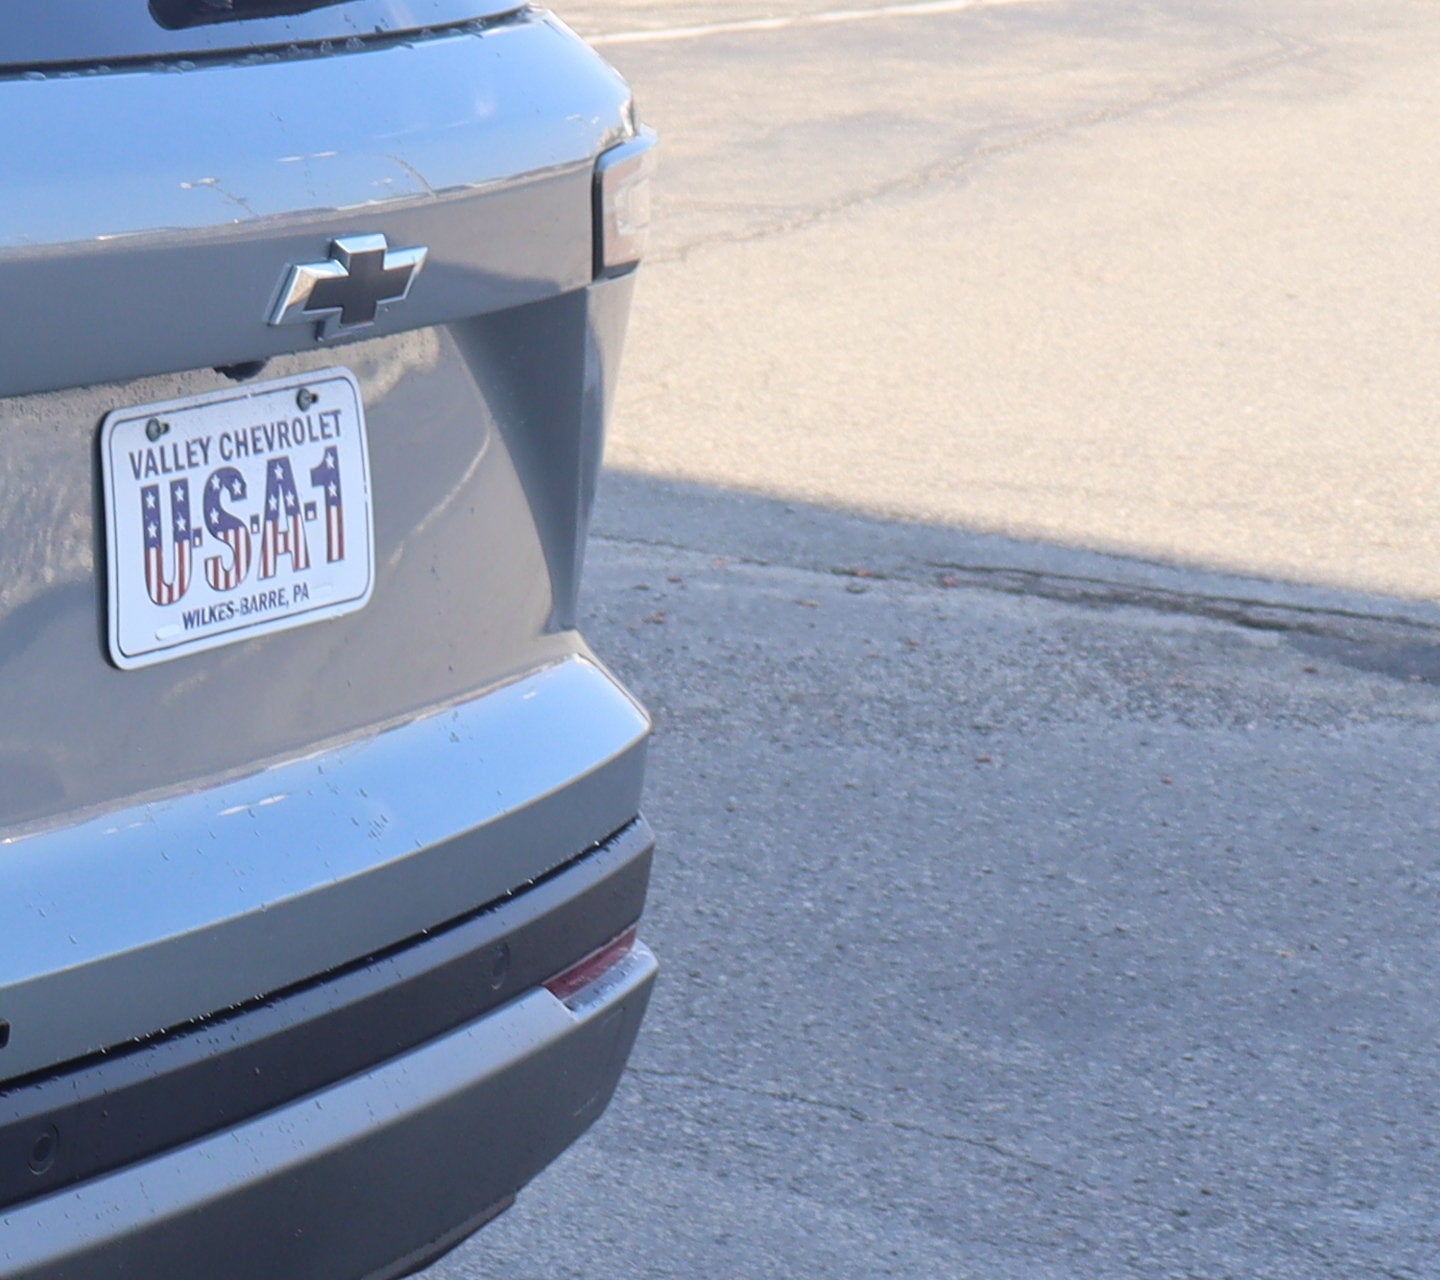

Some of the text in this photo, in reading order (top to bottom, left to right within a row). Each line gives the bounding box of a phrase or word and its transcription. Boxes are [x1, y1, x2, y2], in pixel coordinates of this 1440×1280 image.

[129, 409, 342, 480] VALLEY CHEVROLET
[182, 582, 310, 630] WILKES-BARRE, PA
